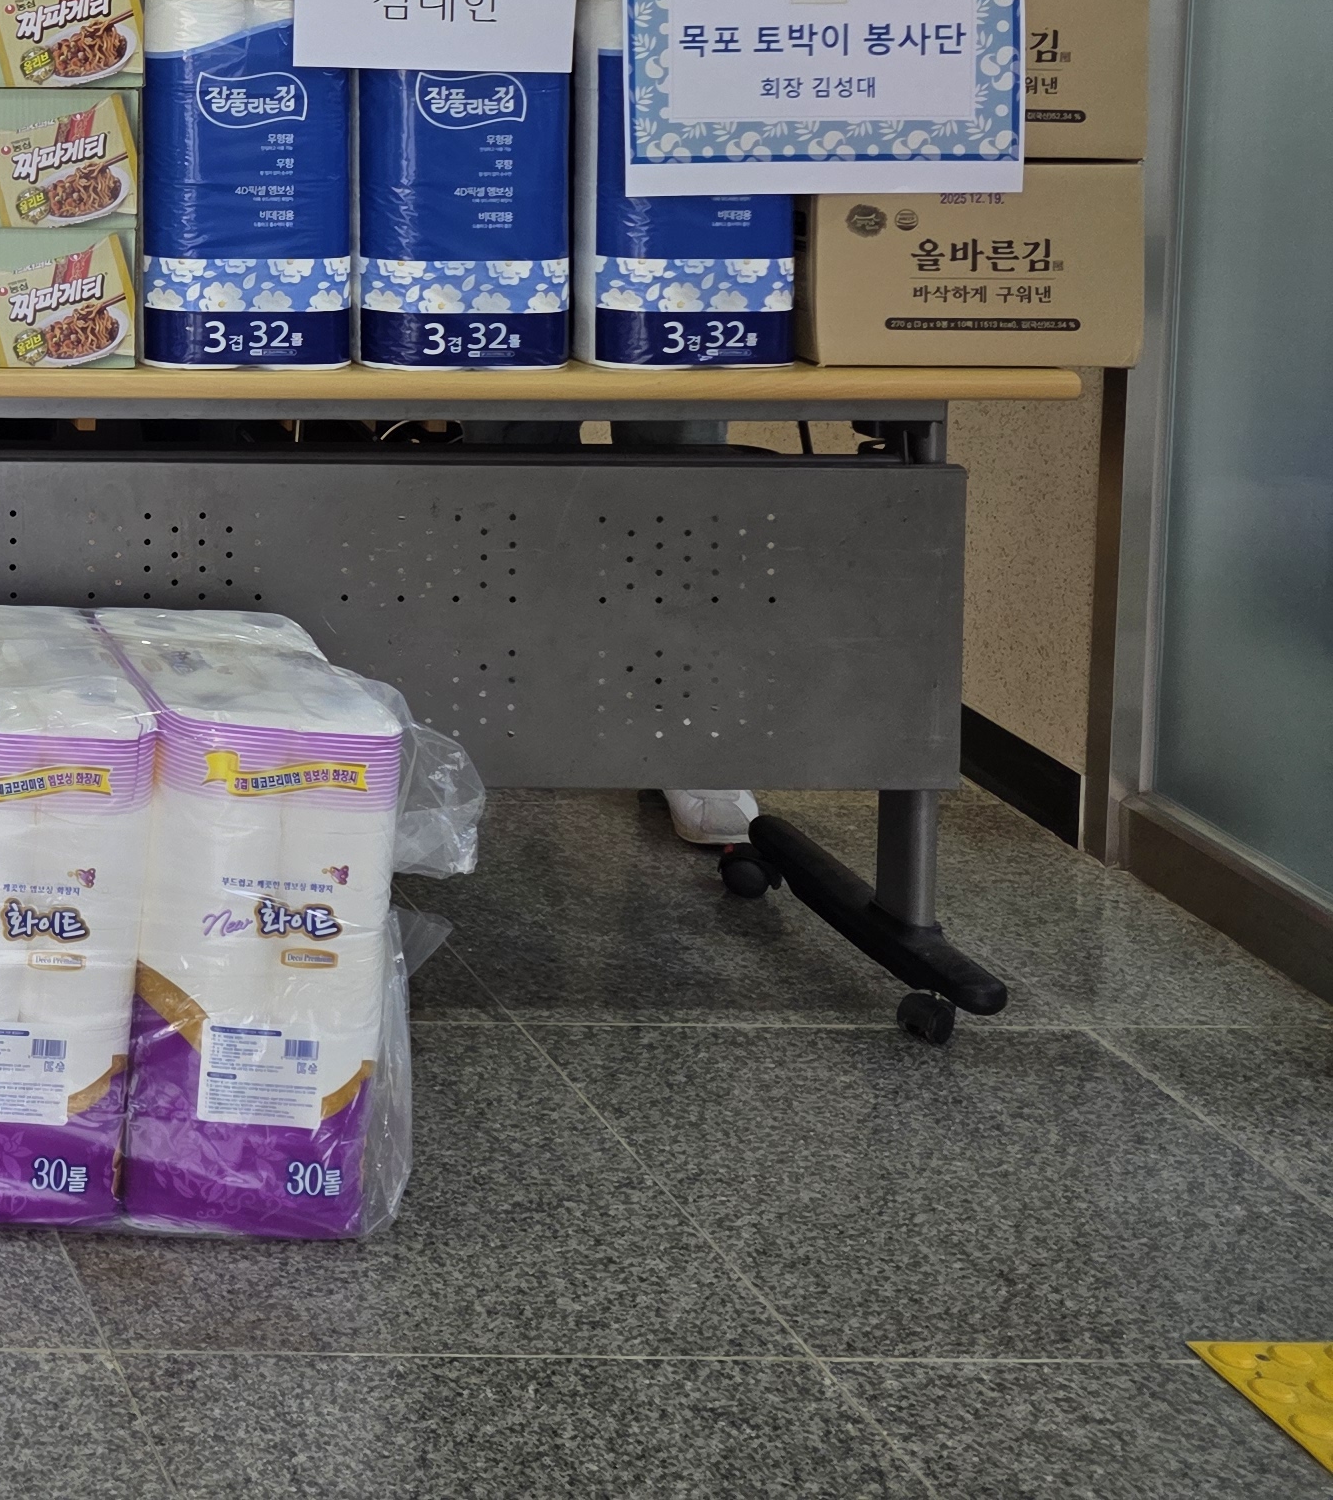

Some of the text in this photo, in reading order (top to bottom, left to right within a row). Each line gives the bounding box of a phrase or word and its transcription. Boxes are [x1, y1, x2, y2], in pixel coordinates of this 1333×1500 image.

[678, 22, 968, 59] 목포 토박이 봉사단
[23, 52, 51, 77] 올리브
[204, 85, 297, 118] 잘풀리는집
[423, 85, 515, 118] 잘풀리는집
[759, 75, 877, 99] 회장 김성대
[910, 237, 1053, 273] 올바른김
[8, 273, 105, 326] 짜파게티
[912, 283, 1052, 305] 바삭하게 구워낸
[423, 322, 463, 356] 3겹
[661, 320, 702, 355] 3겹
[234, 768, 358, 791] 3겹 데코프리미엄 엠보싱 화장지
[259, 897, 339, 937] 화이트
